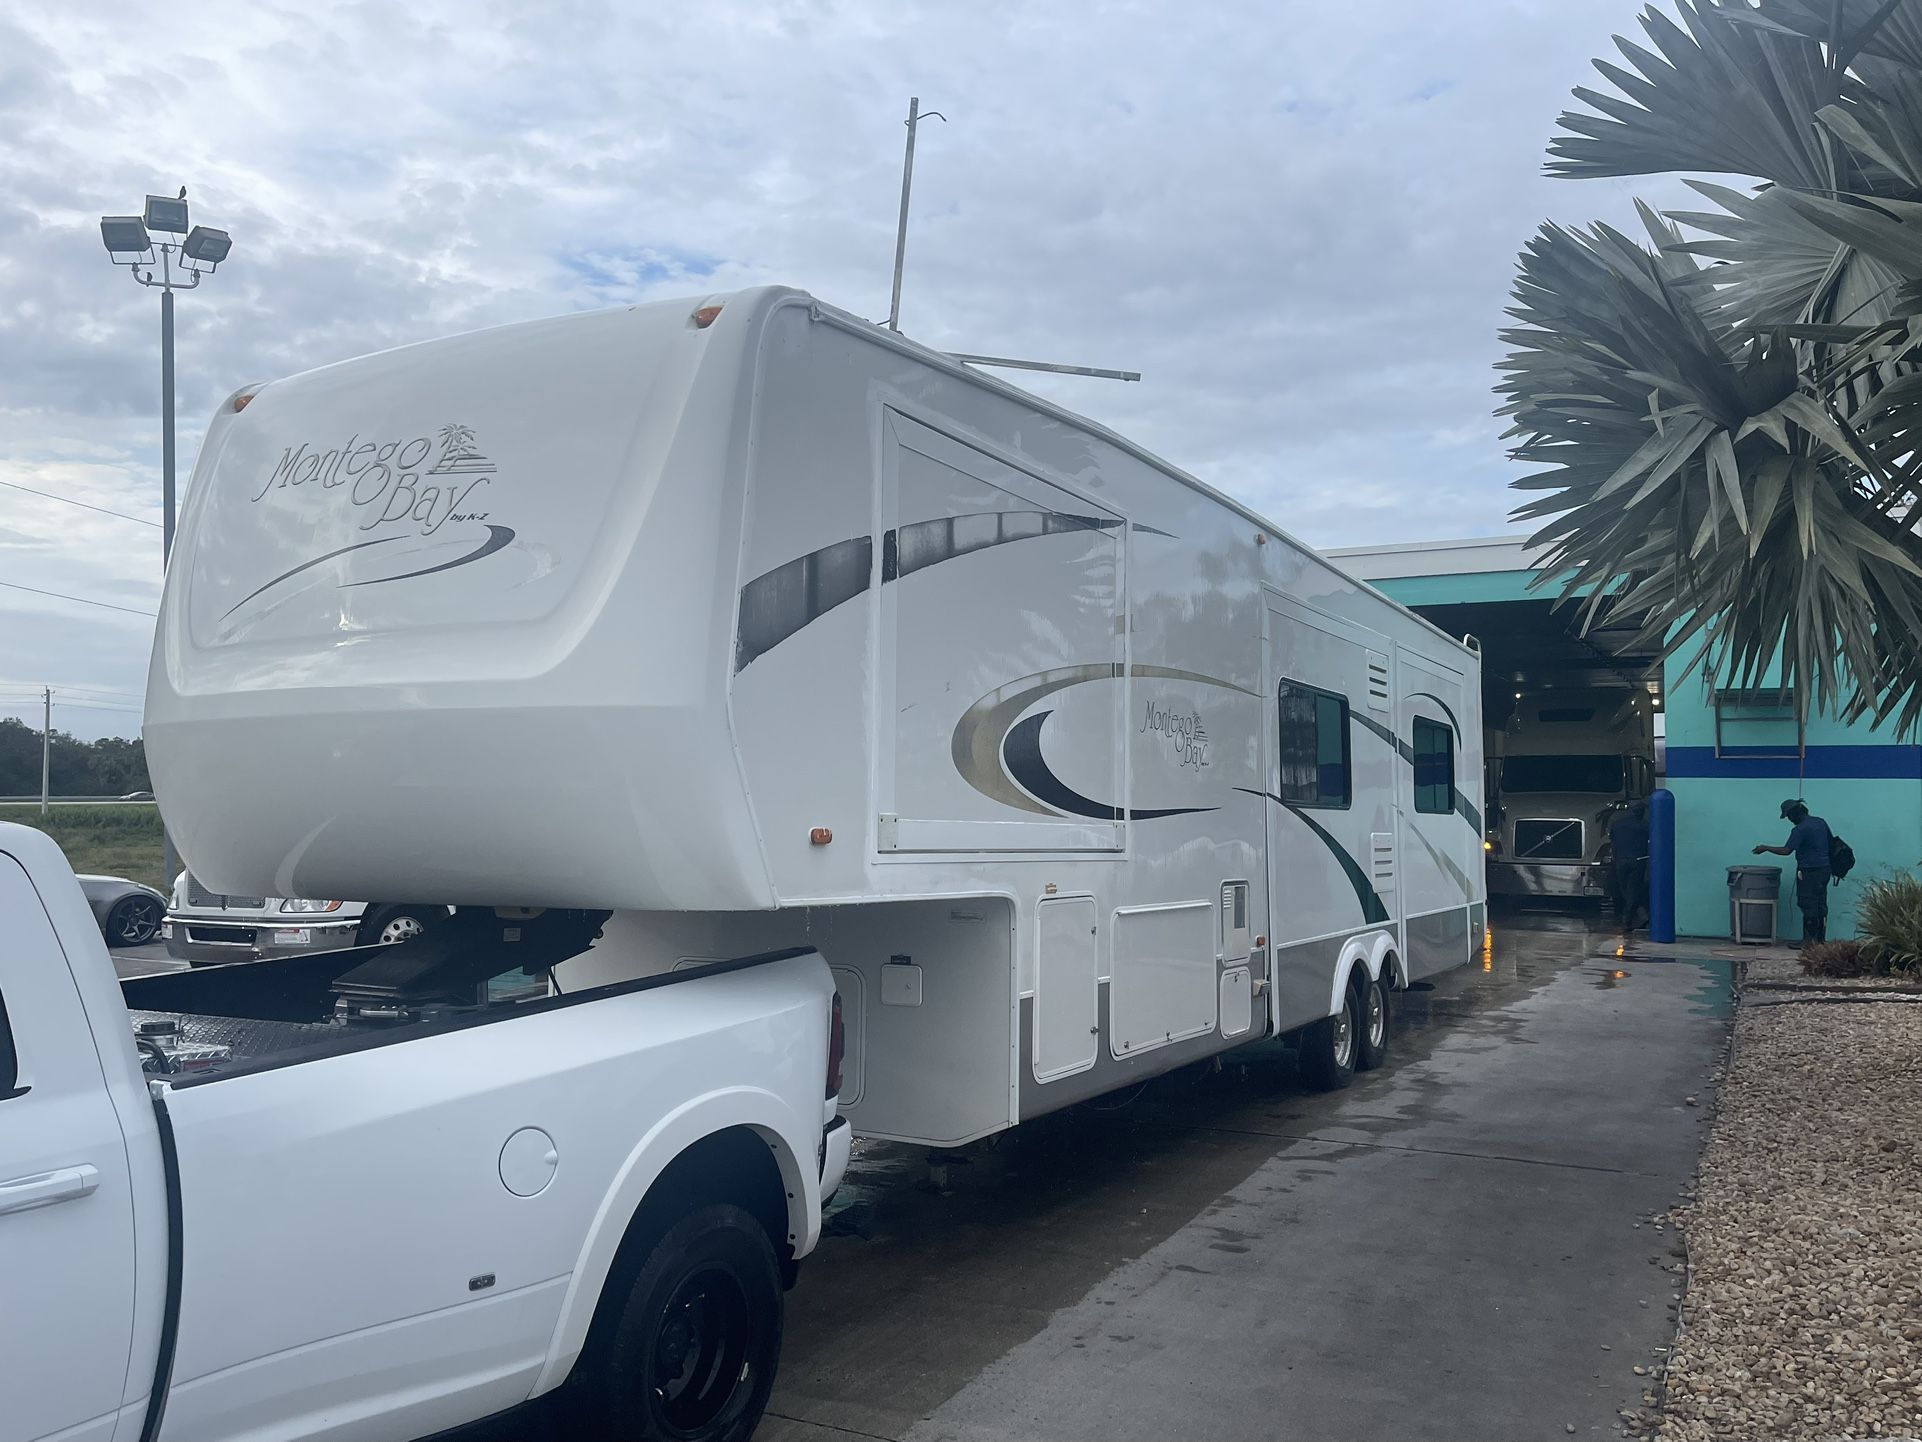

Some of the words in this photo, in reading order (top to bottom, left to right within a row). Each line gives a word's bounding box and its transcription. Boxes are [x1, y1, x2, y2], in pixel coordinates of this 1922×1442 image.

[251, 433, 432, 506] Montego
[359, 472, 491, 536] Bay
[1139, 700, 1193, 753] Montego
[1179, 737, 1209, 773] Bay
